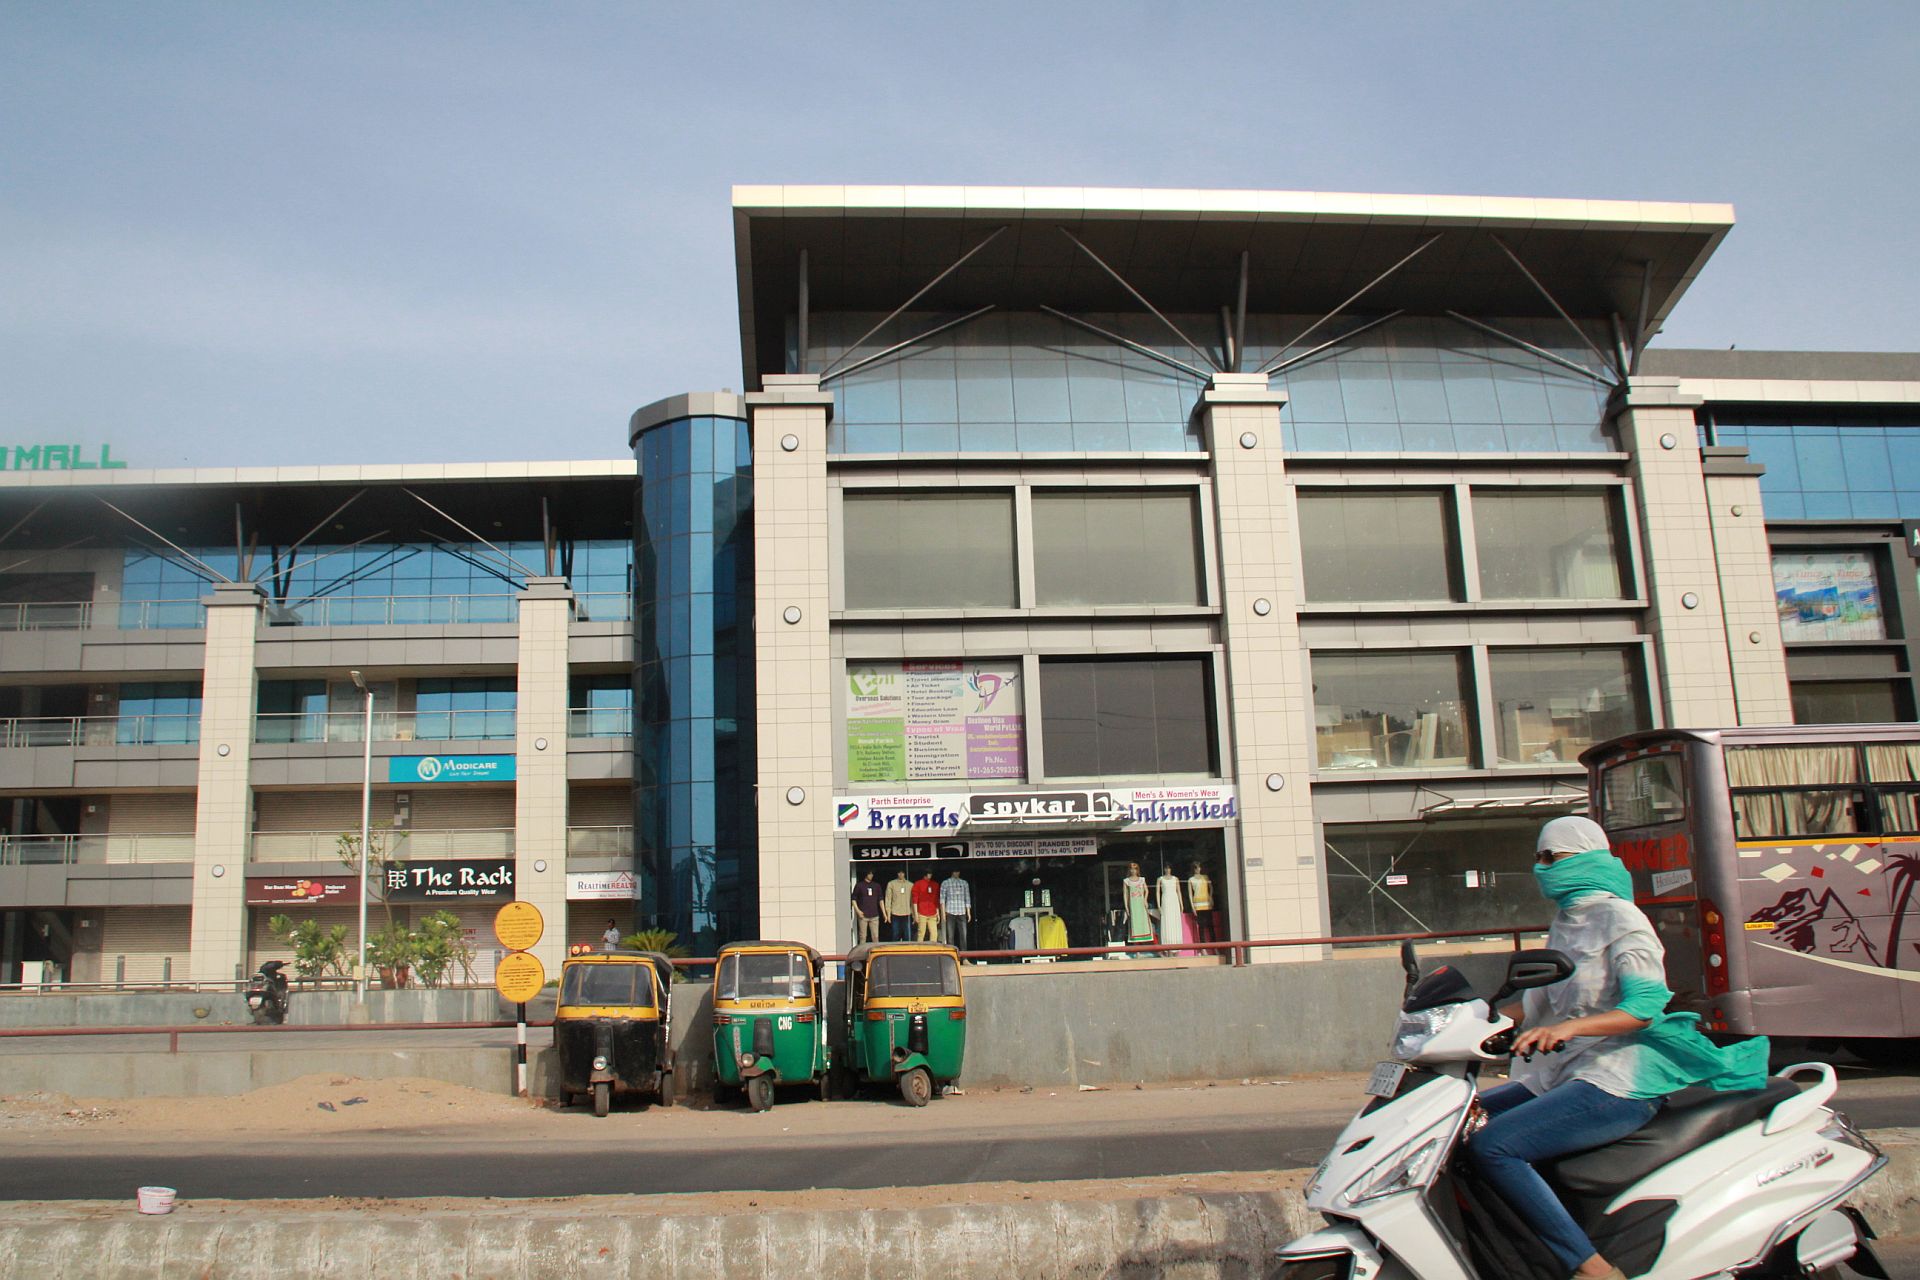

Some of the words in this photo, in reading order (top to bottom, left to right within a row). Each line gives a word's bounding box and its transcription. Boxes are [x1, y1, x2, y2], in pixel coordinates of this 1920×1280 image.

[14, 443, 128, 470] MALL
[1135, 791, 1157, 799] Men's
[1166, 790, 1199, 798] Women's
[1200, 789, 1219, 797] Wear
[871, 797, 891, 805] Parth
[893, 796, 932, 806] Enterprise
[983, 797, 1076, 816] spykar
[868, 807, 959, 830] Brands
[1006, 840, 1033, 848] DISCOUNT
[1072, 839, 1095, 847] SHOES
[861, 846, 923, 858] spykar
[976, 849, 987, 857] ON
[988, 848, 1010, 857] MEN'S
[1012, 848, 1033, 856] WEAR
[411, 867, 453, 887] The
[459, 865, 513, 886] Rack
[458, 889, 480, 897] Quality
[777, 1015, 793, 1032] CNG
